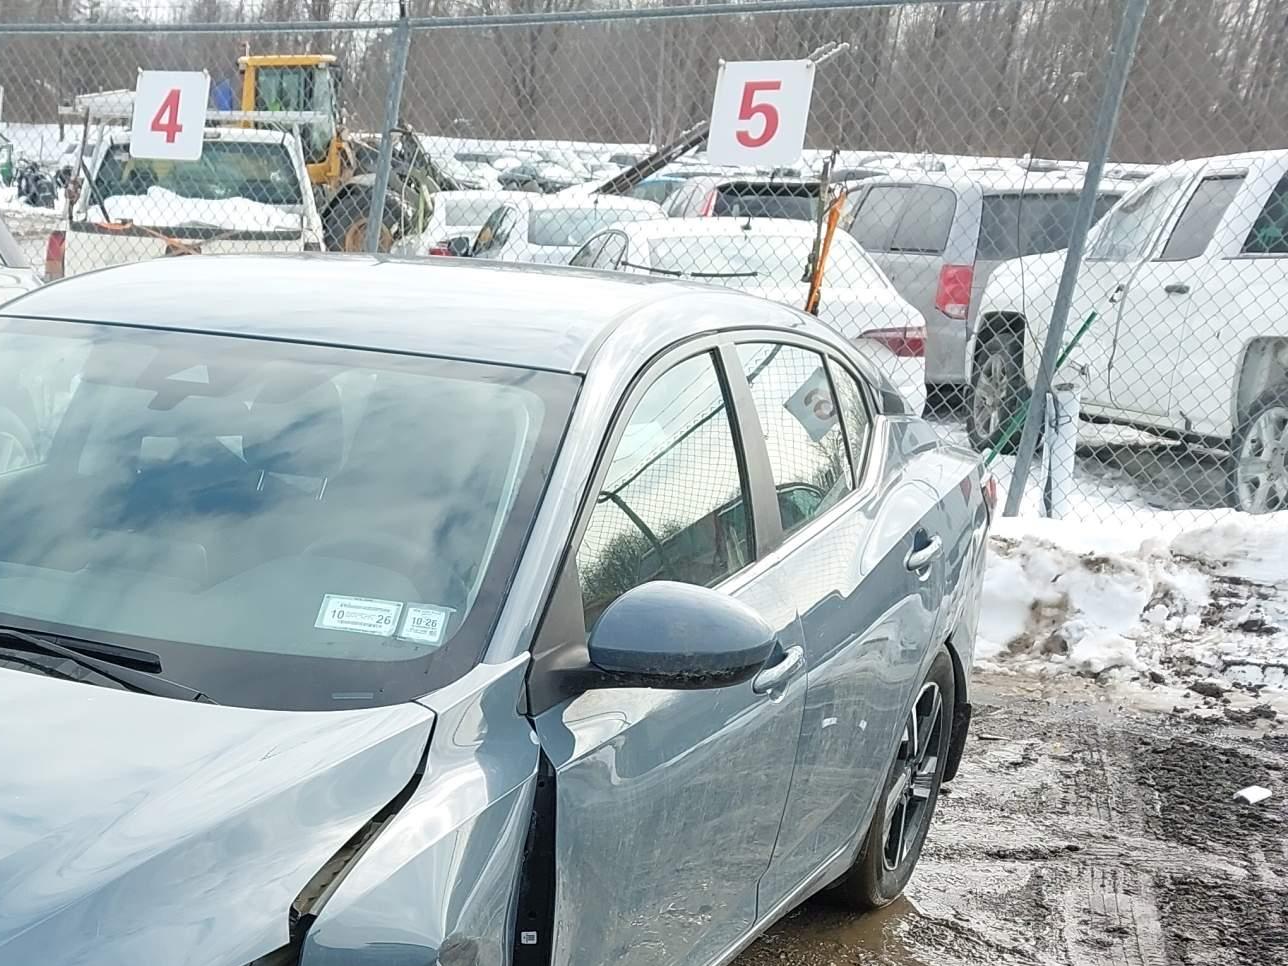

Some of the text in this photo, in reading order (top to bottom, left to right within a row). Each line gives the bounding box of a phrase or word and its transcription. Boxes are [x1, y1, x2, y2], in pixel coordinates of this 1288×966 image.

[150, 88, 184, 144] 4
[735, 80, 782, 149] 5
[330, 609, 345, 620] 10
[375, 614, 392, 625] 26
